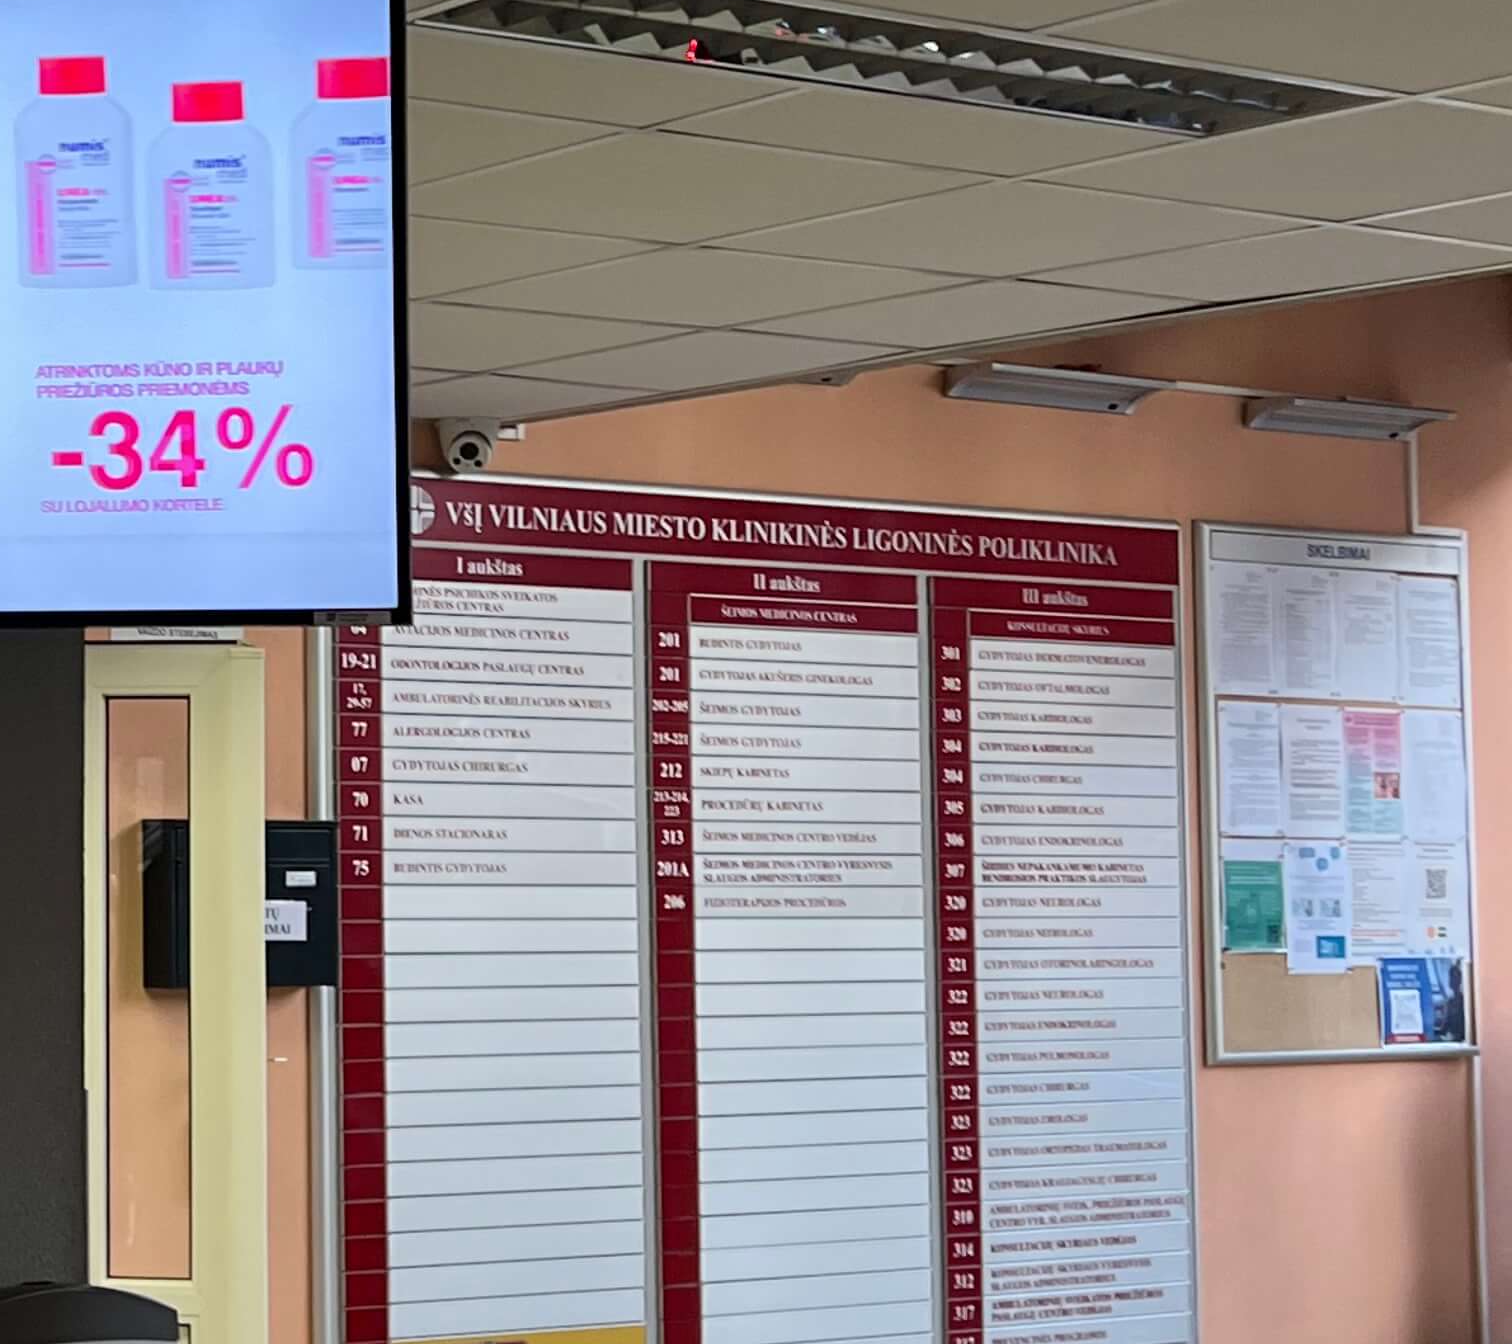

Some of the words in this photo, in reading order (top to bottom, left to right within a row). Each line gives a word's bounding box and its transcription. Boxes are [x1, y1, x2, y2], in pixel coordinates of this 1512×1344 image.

[35, 364, 140, 378] ATRINKTOMS
[144, 362, 192, 377] KŪNO
[196, 363, 212, 376] IR
[216, 361, 283, 378] PLAUKŲ
[35, 382, 134, 398] PRIEŽIŪROS
[138, 380, 250, 397] PRIEMONĖMS
[51, 403, 314, 490] -34%
[40, 500, 63, 513] SU
[67, 498, 149, 512] LOJALUMO
[446, 501, 484, 533] VšĮ
[488, 504, 607, 534] VILNIAUS
[613, 512, 706, 540] MIESTO
[711, 516, 847, 550] KLINIKINĖS
[852, 526, 974, 557] LIGONINĖS
[978, 538, 1118, 566] POLIKLINIKA
[1306, 544, 1370, 560] SKELBIMAI
[467, 558, 523, 576] aukštas
[753, 574, 766, 590] II
[769, 575, 820, 593] aukštas
[1042, 590, 1088, 606] aukštas
[519, 629, 570, 641] CENTRAS
[658, 632, 680, 648] 201
[342, 652, 376, 670] 19-21
[538, 663, 584, 676] CENTRAS
[659, 667, 680, 682] 201
[352, 721, 368, 737] 77
[351, 756, 368, 772] 07
[660, 763, 683, 778] 212
[352, 792, 368, 807] 70
[393, 794, 424, 806] KASA
[352, 825, 368, 841] 71
[661, 830, 684, 845] 313
[352, 860, 370, 876] 75
